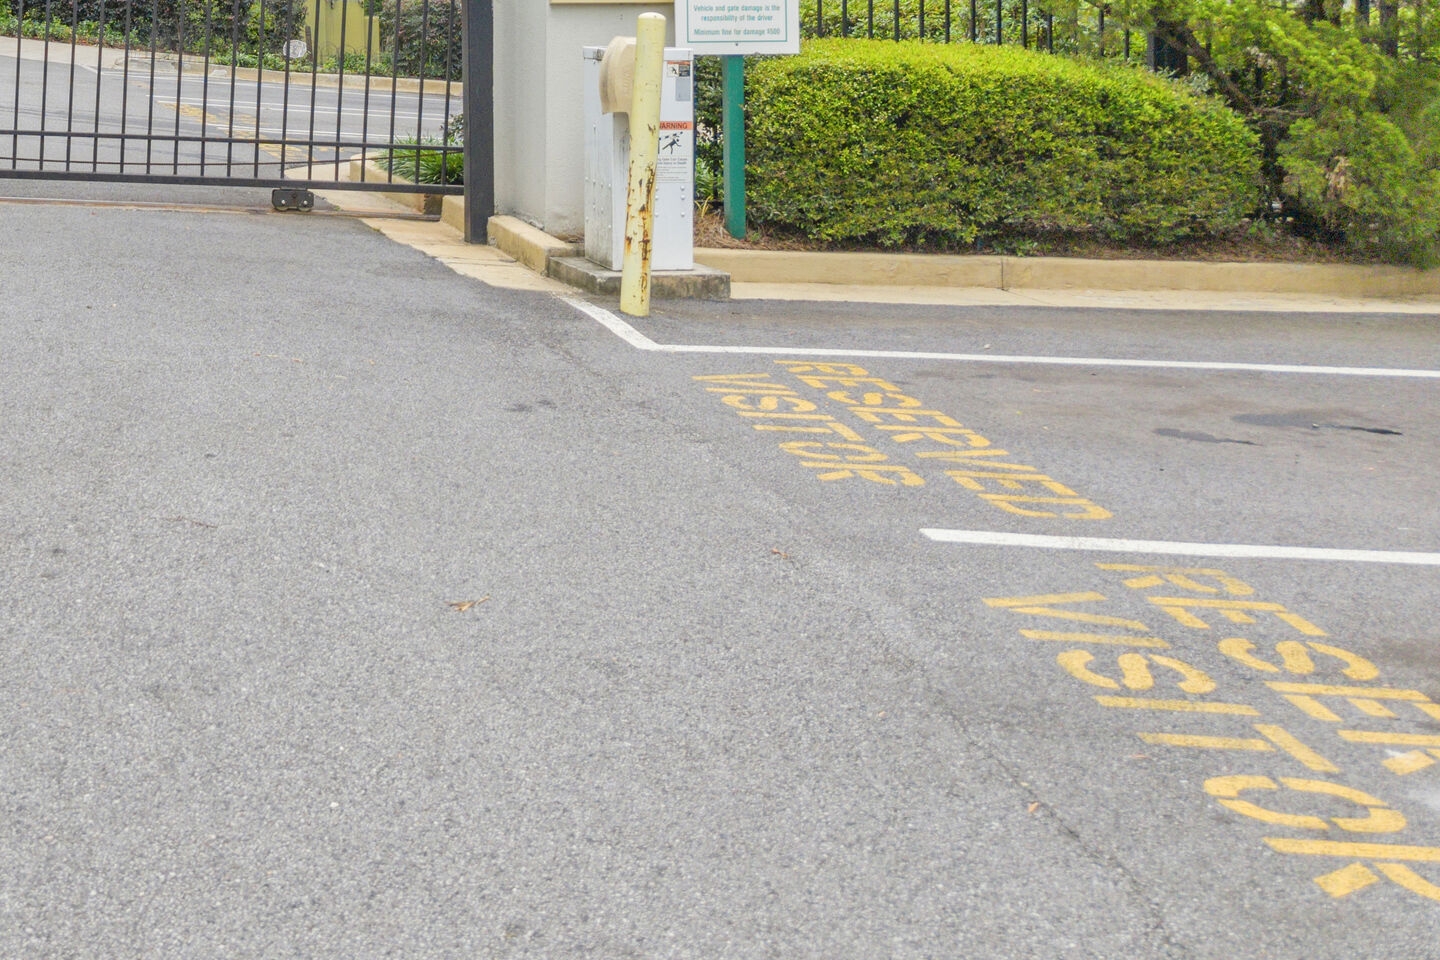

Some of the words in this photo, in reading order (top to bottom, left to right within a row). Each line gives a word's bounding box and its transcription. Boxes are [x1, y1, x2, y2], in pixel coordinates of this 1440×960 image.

[660, 122, 688, 130] ARNING
[692, 373, 926, 487] VISITOR
[773, 360, 1114, 521] RESERVED
